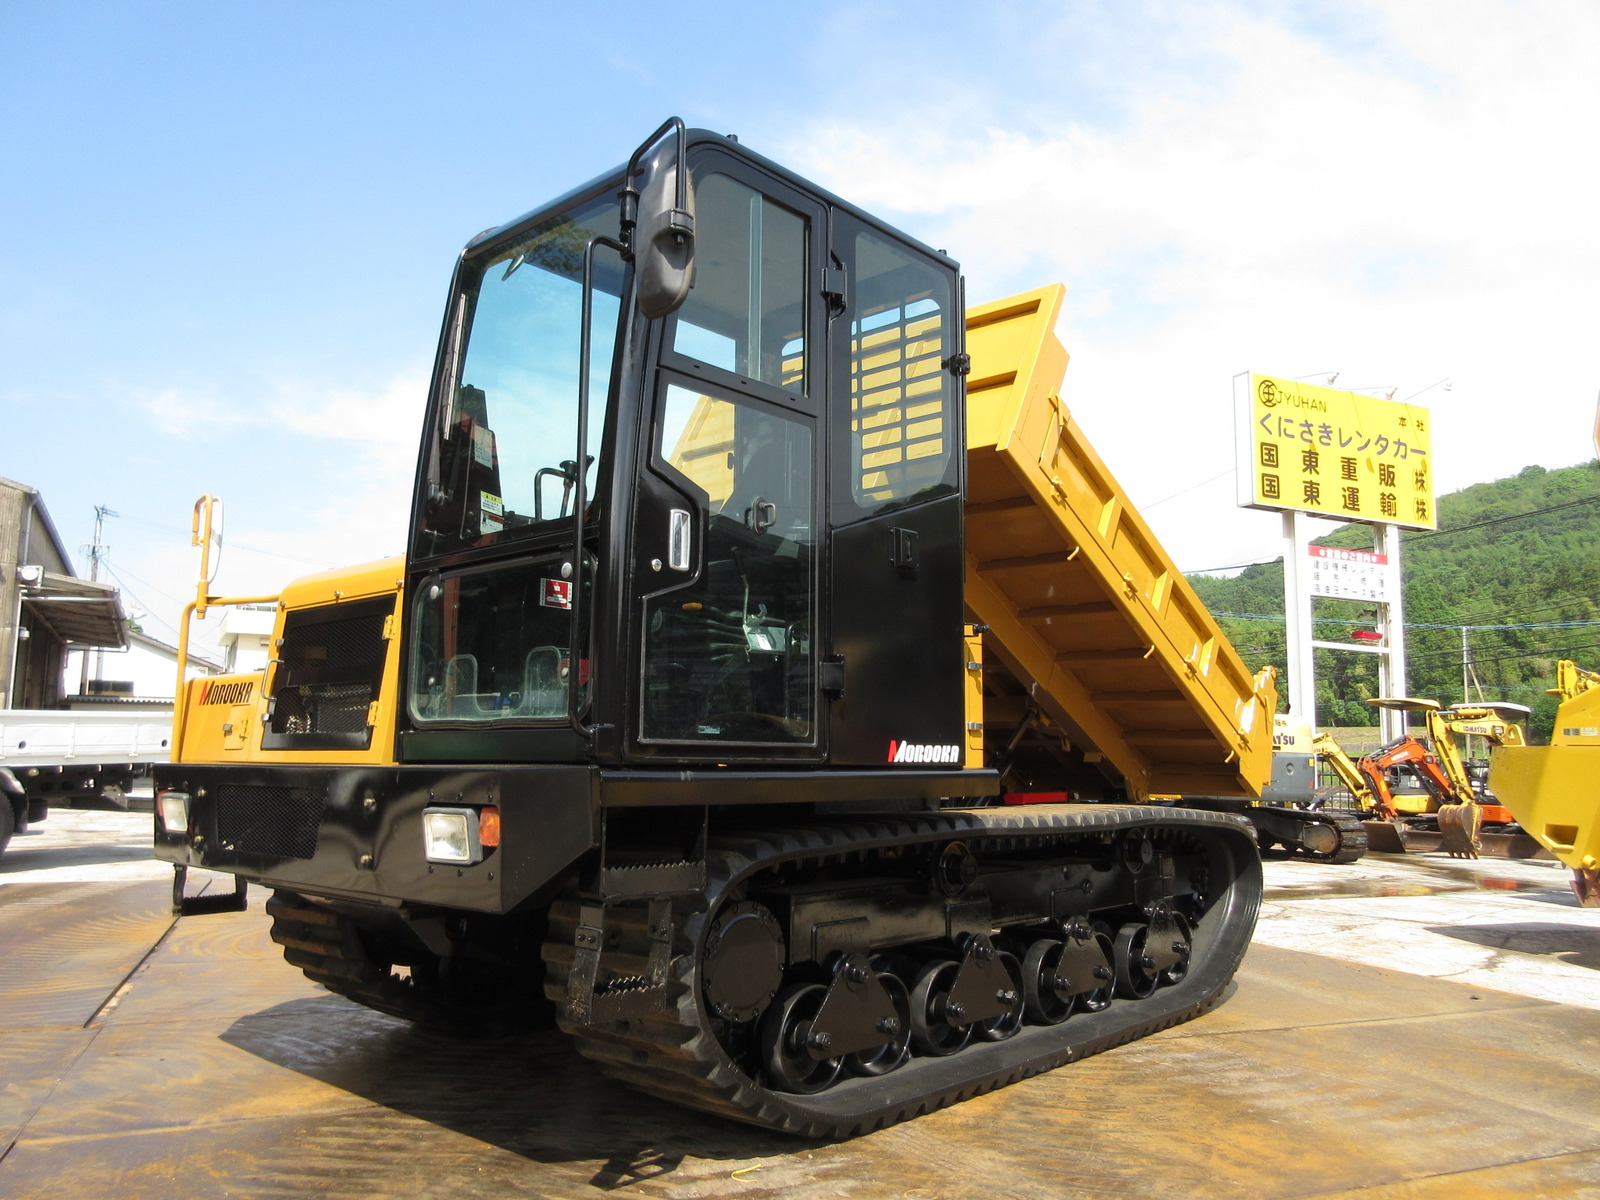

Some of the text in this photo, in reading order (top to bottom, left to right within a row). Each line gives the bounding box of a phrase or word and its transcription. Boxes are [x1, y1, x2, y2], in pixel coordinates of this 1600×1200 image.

[1275, 390, 1327, 413] JYUHAN
[1259, 412, 1427, 460] くにさきレンタカー
[1398, 416, 1425, 432] 本社
[198, 680, 254, 706] MOROOKA
[887, 739, 960, 763] MOROOKA
